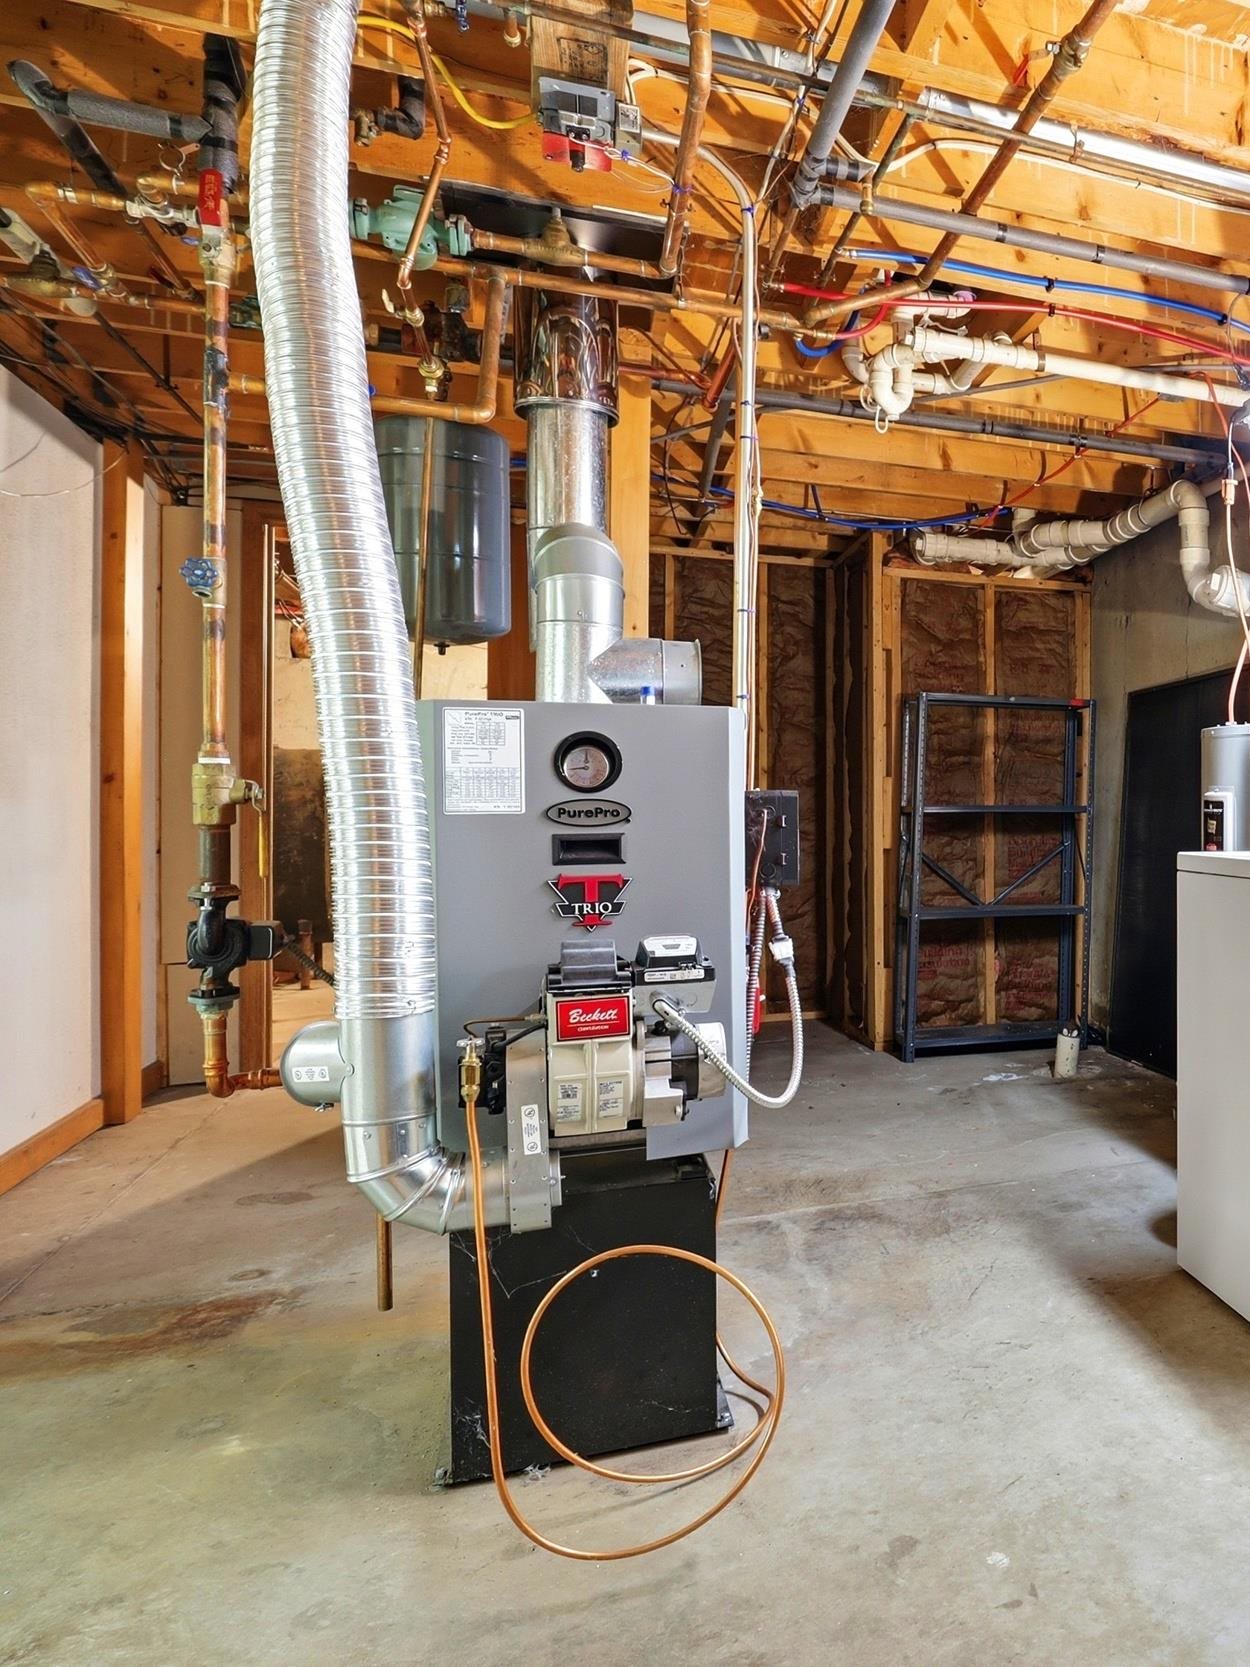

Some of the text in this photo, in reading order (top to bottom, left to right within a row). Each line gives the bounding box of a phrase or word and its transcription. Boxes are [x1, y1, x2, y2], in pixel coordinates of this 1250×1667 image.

[557, 807, 621, 818] PurePro
[571, 902, 612, 914] TRIO
[568, 1008, 619, 1024] Beckett
